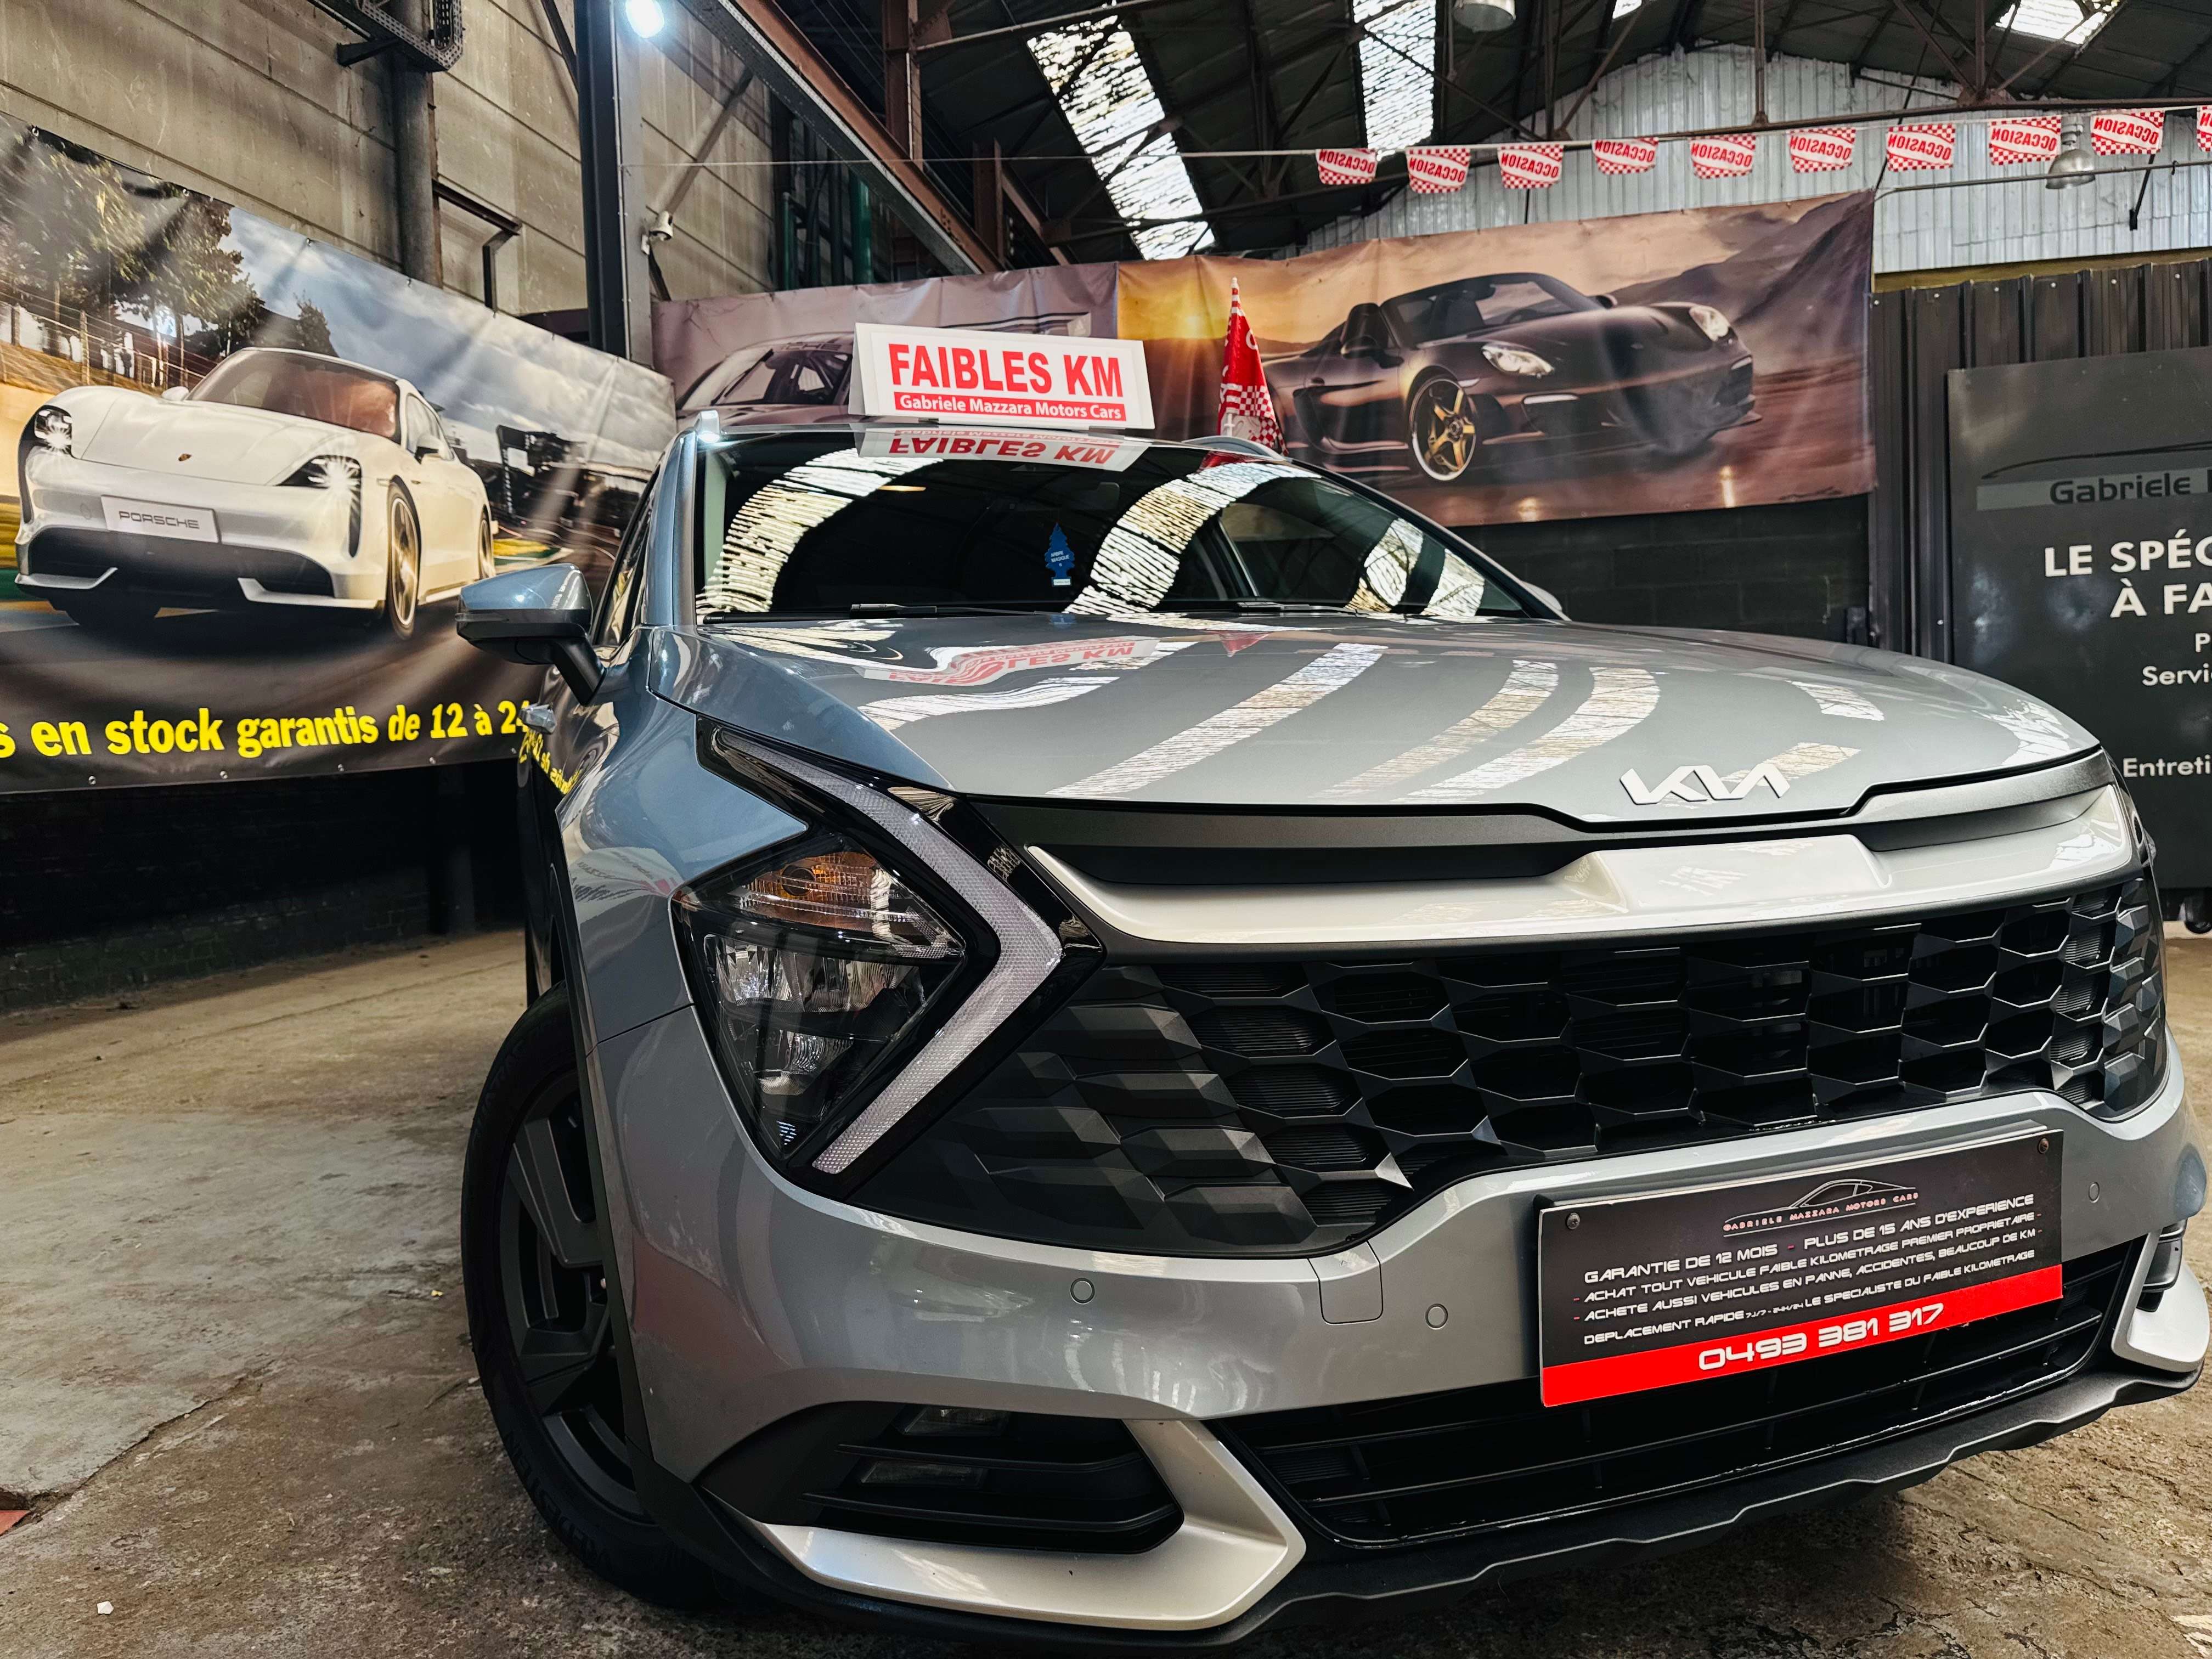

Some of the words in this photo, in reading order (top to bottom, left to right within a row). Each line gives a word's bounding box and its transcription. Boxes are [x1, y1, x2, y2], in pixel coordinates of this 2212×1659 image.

[888, 343, 1052, 394] FAIBLES
[1063, 355, 1123, 397] KM
[900, 394, 966, 411] Gabriele
[969, 399, 1032, 415] Mazzara
[1035, 403, 1087, 418] Motors
[1090, 405, 1121, 419] Cars
[2050, 473, 2191, 504] Gabriele
[119, 511, 200, 529] PORSCHE
[2045, 544, 2092, 577] LE
[2110, 578, 2147, 618] À
[2142, 663, 2212, 686] Servi
[30, 721, 92, 757] en
[105, 708, 225, 755] stock
[237, 706, 379, 758] garantis
[388, 704, 421, 741] de
[430, 702, 469, 738] 12
[474, 703, 493, 736] à
[1620, 763, 1790, 805] KIA
[1723, 1215, 1782, 1231] GABRIELE
[1846, 1198, 1886, 1211] MOTORS
[1893, 1192, 1918, 1203] CARS
[1584, 1286, 1636, 1302] ACHAT
[1641, 1279, 1683, 1293] TOUT
[1687, 1268, 1756, 1286] VEHICULE
[1760, 1259, 1807, 1275] FAIBLE
[1810, 1242, 1898, 1266] KILOMETRAGE
[1902, 1231, 1953, 1248] PREMIER
[1956, 1212, 2034, 1237] PROPRIETAIRE
[1585, 1260, 1680, 1283] GARANTIE
[1685, 1255, 1710, 1269] DE
[1716, 1252, 1731, 1263] 12
[1737, 1244, 1778, 1261] MOIS
[1804, 1232, 1848, 1249] PLUS
[1853, 1227, 1875, 1240] DE
[1880, 1223, 1895, 1235] 15
[1900, 1216, 1931, 1232] ANS
[1936, 1194, 2033, 1224] D'EXPERIENCE
[1585, 1303, 1647, 1321] ACHETE
[1652, 1295, 1697, 1311] AUSSI
[1701, 1282, 1779, 1302] VEHICULES
[1783, 1277, 1802, 1288] EN
[1805, 1268, 1852, 1284] PANNE,
[1856, 1251, 1935, 1275] ACCIDENTES,
[1939, 1237, 2000, 1257] BEAUCOUP
[2003, 1233, 2017, 1244] DE
[2020, 1228, 2035, 1239] KM
[1584, 1319, 1691, 1344] DEPLACEMENT
[1695, 1311, 1743, 1327] RAPIDE
[1805, 1296, 1821, 1307] LE
[1905, 1276, 1920, 1286] DU
[1923, 1267, 1961, 1282] FAIBLE
[1964, 1250, 2034, 1273] KILOMETRAGE
[1699, 1333, 1807, 1370] 0493
[1819, 1318, 1878, 1347] 381
[1889, 1302, 1944, 1332] 317
